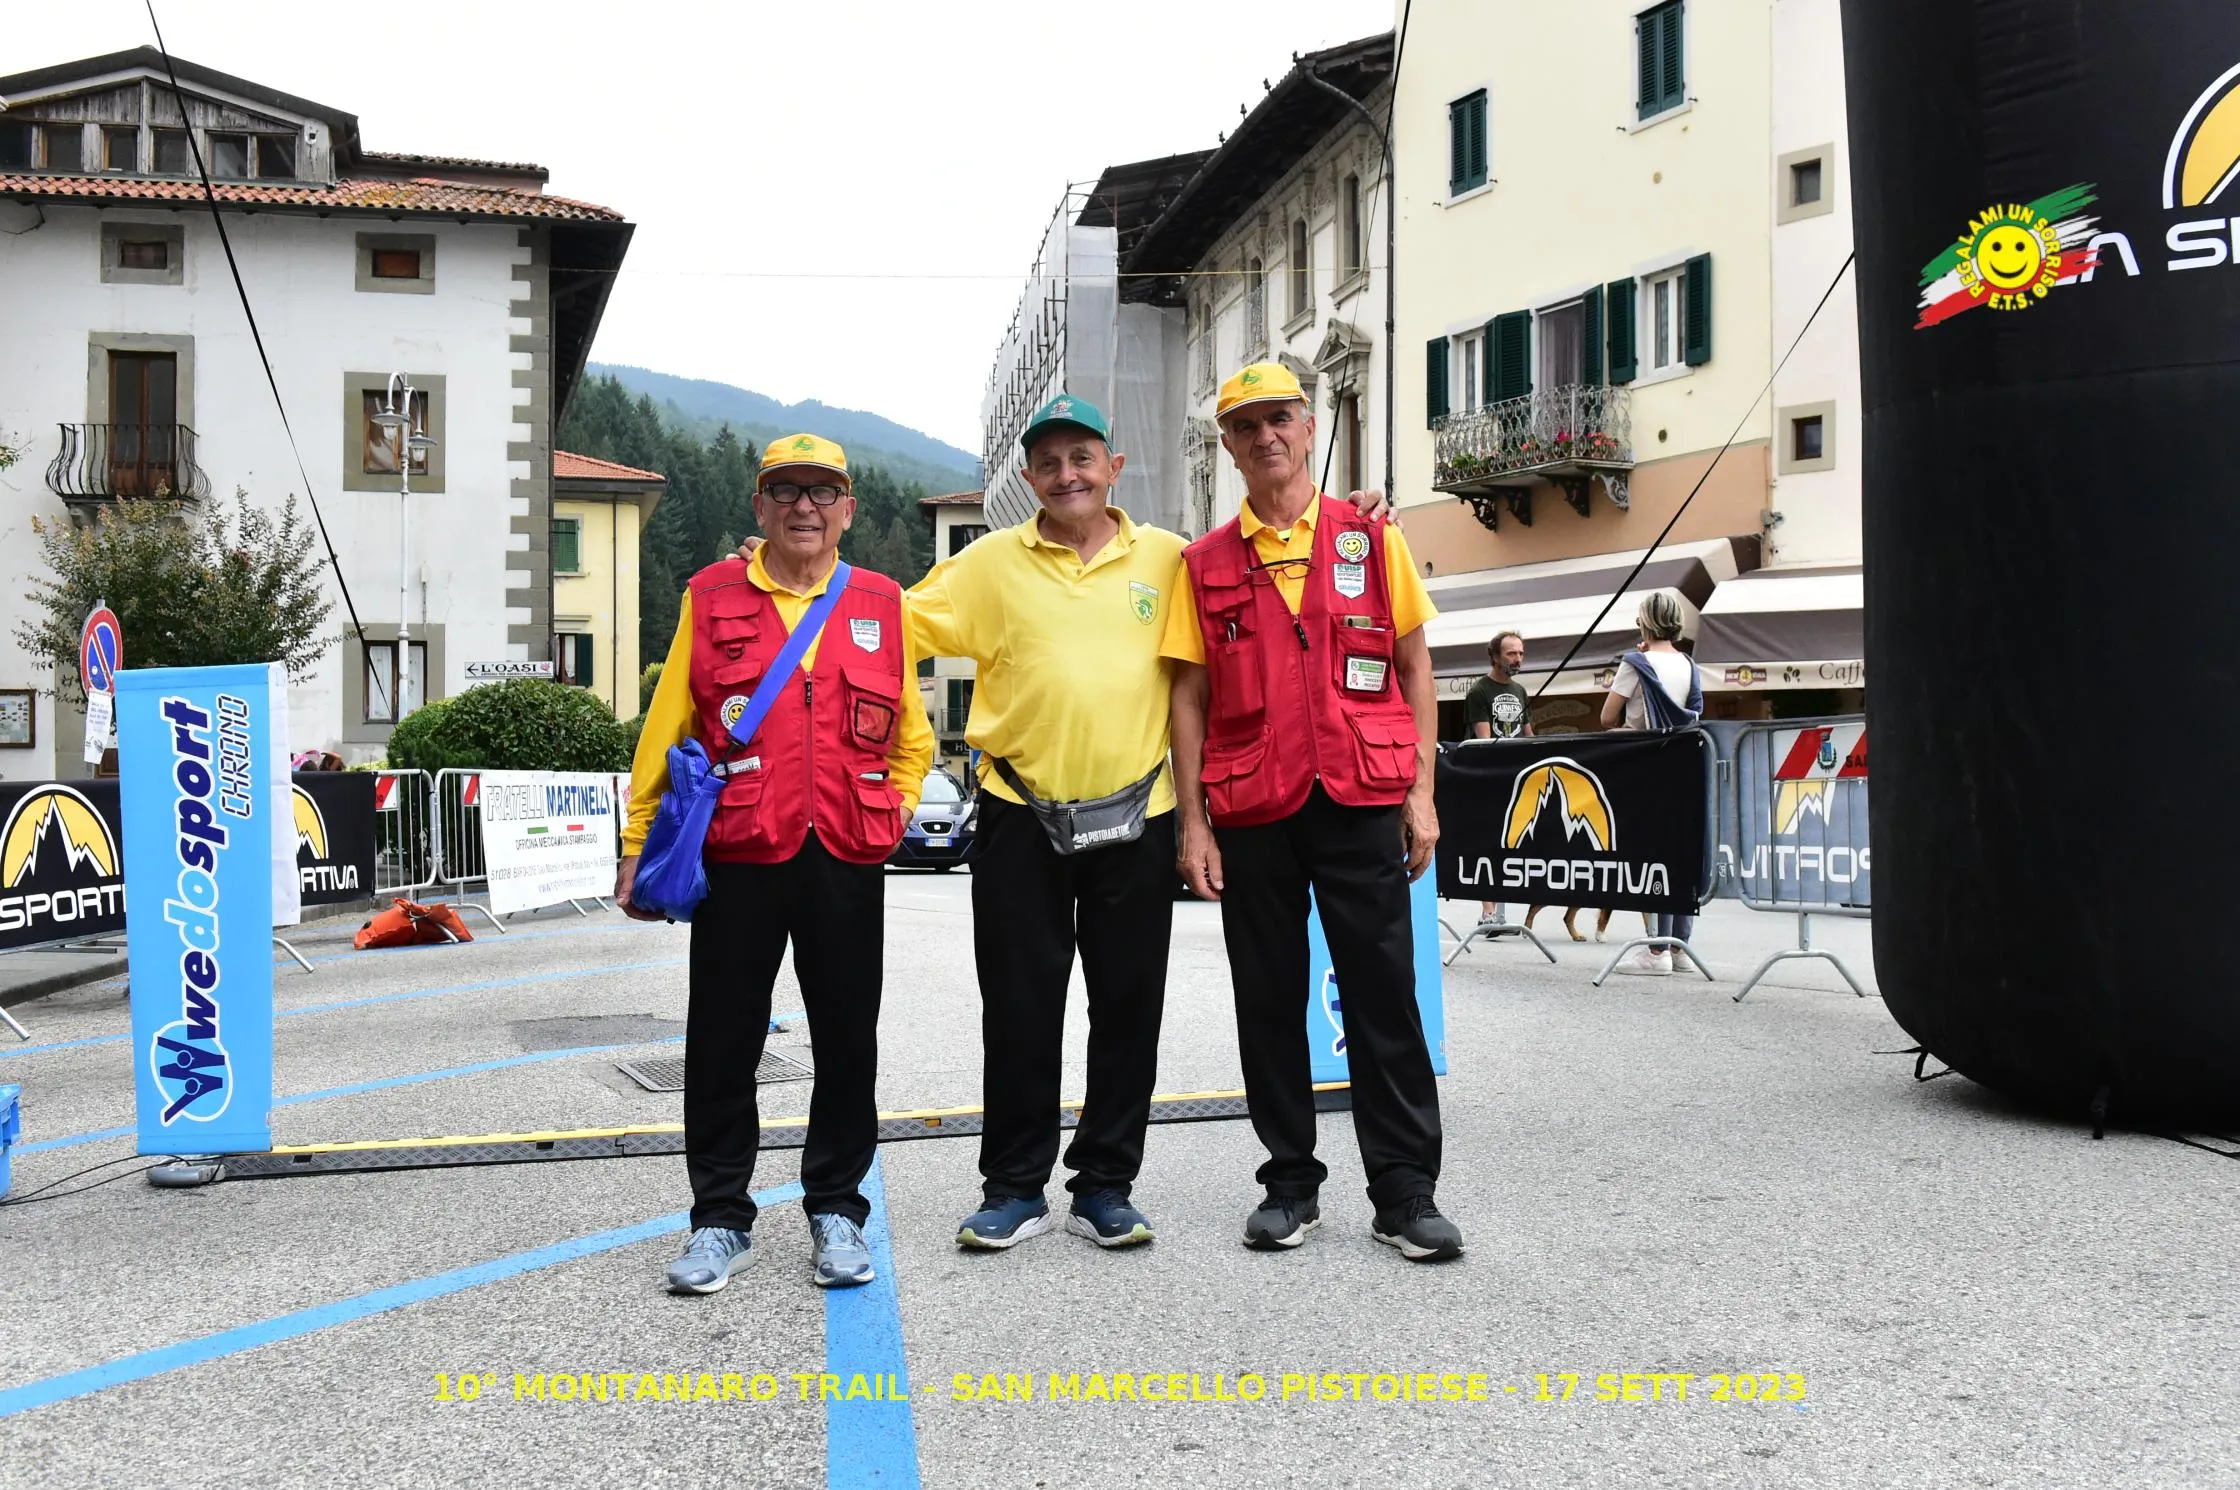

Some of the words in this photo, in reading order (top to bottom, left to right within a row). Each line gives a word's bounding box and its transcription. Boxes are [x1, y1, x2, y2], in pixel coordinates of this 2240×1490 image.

[2166, 216, 2240, 271] S
[481, 663, 537, 673] L'OASI
[216, 693, 252, 820] CHRONO
[1845, 754, 1868, 768] SA
[486, 785, 545, 821] FRATELLI
[546, 785, 611, 817] MARTINELLI
[515, 836, 538, 850] OFFICINA
[539, 834, 569, 848] MECCANICA
[569, 833, 598, 846] STAMPAGGIO
[160, 695, 229, 1042] wedosport
[1458, 856, 1495, 886] LA
